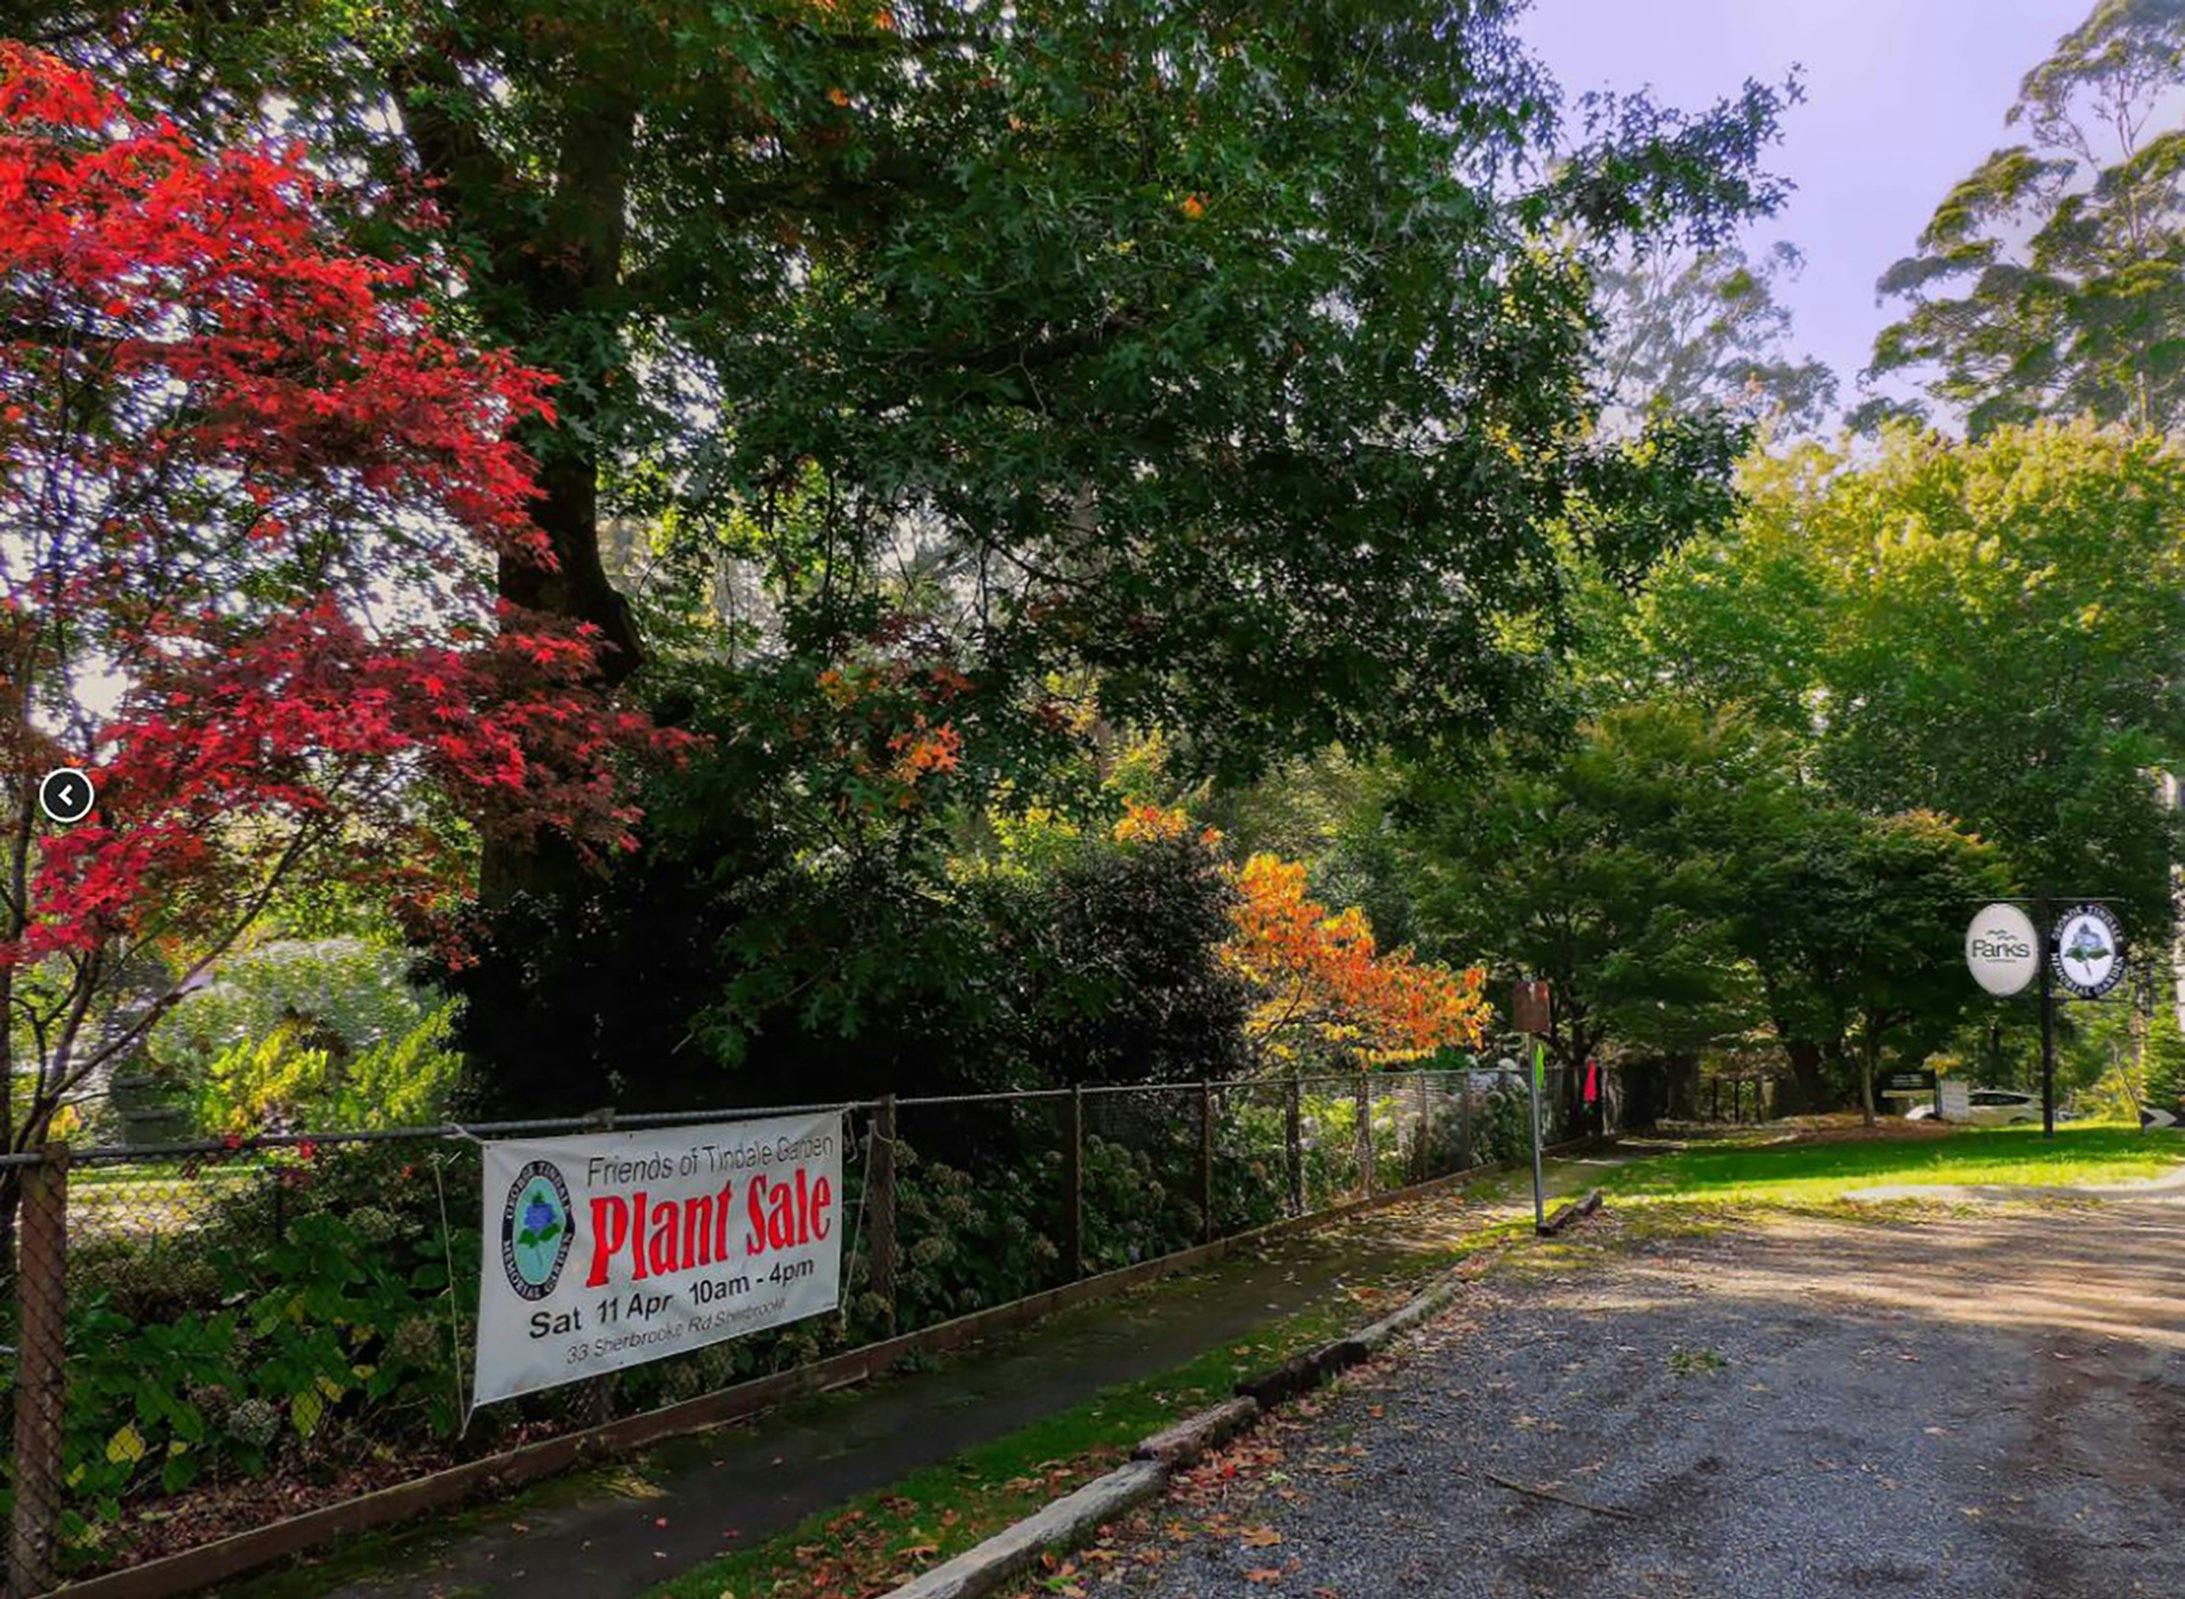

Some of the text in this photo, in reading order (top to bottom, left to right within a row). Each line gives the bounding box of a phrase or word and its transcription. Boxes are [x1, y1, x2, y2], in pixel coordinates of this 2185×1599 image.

[1972, 939, 2031, 957] Parks
[587, 1135, 833, 1186] Friends of Tindale Garden
[585, 1163, 832, 1288] Plant Sale
[529, 1307, 582, 1340] Sat
[597, 1298, 618, 1324] 11
[626, 1292, 674, 1322] Apr
[689, 1275, 750, 1305] 10am
[769, 1259, 814, 1287] 4pm
[567, 1343, 589, 1365] 33
[688, 1315, 712, 1332] Rd
